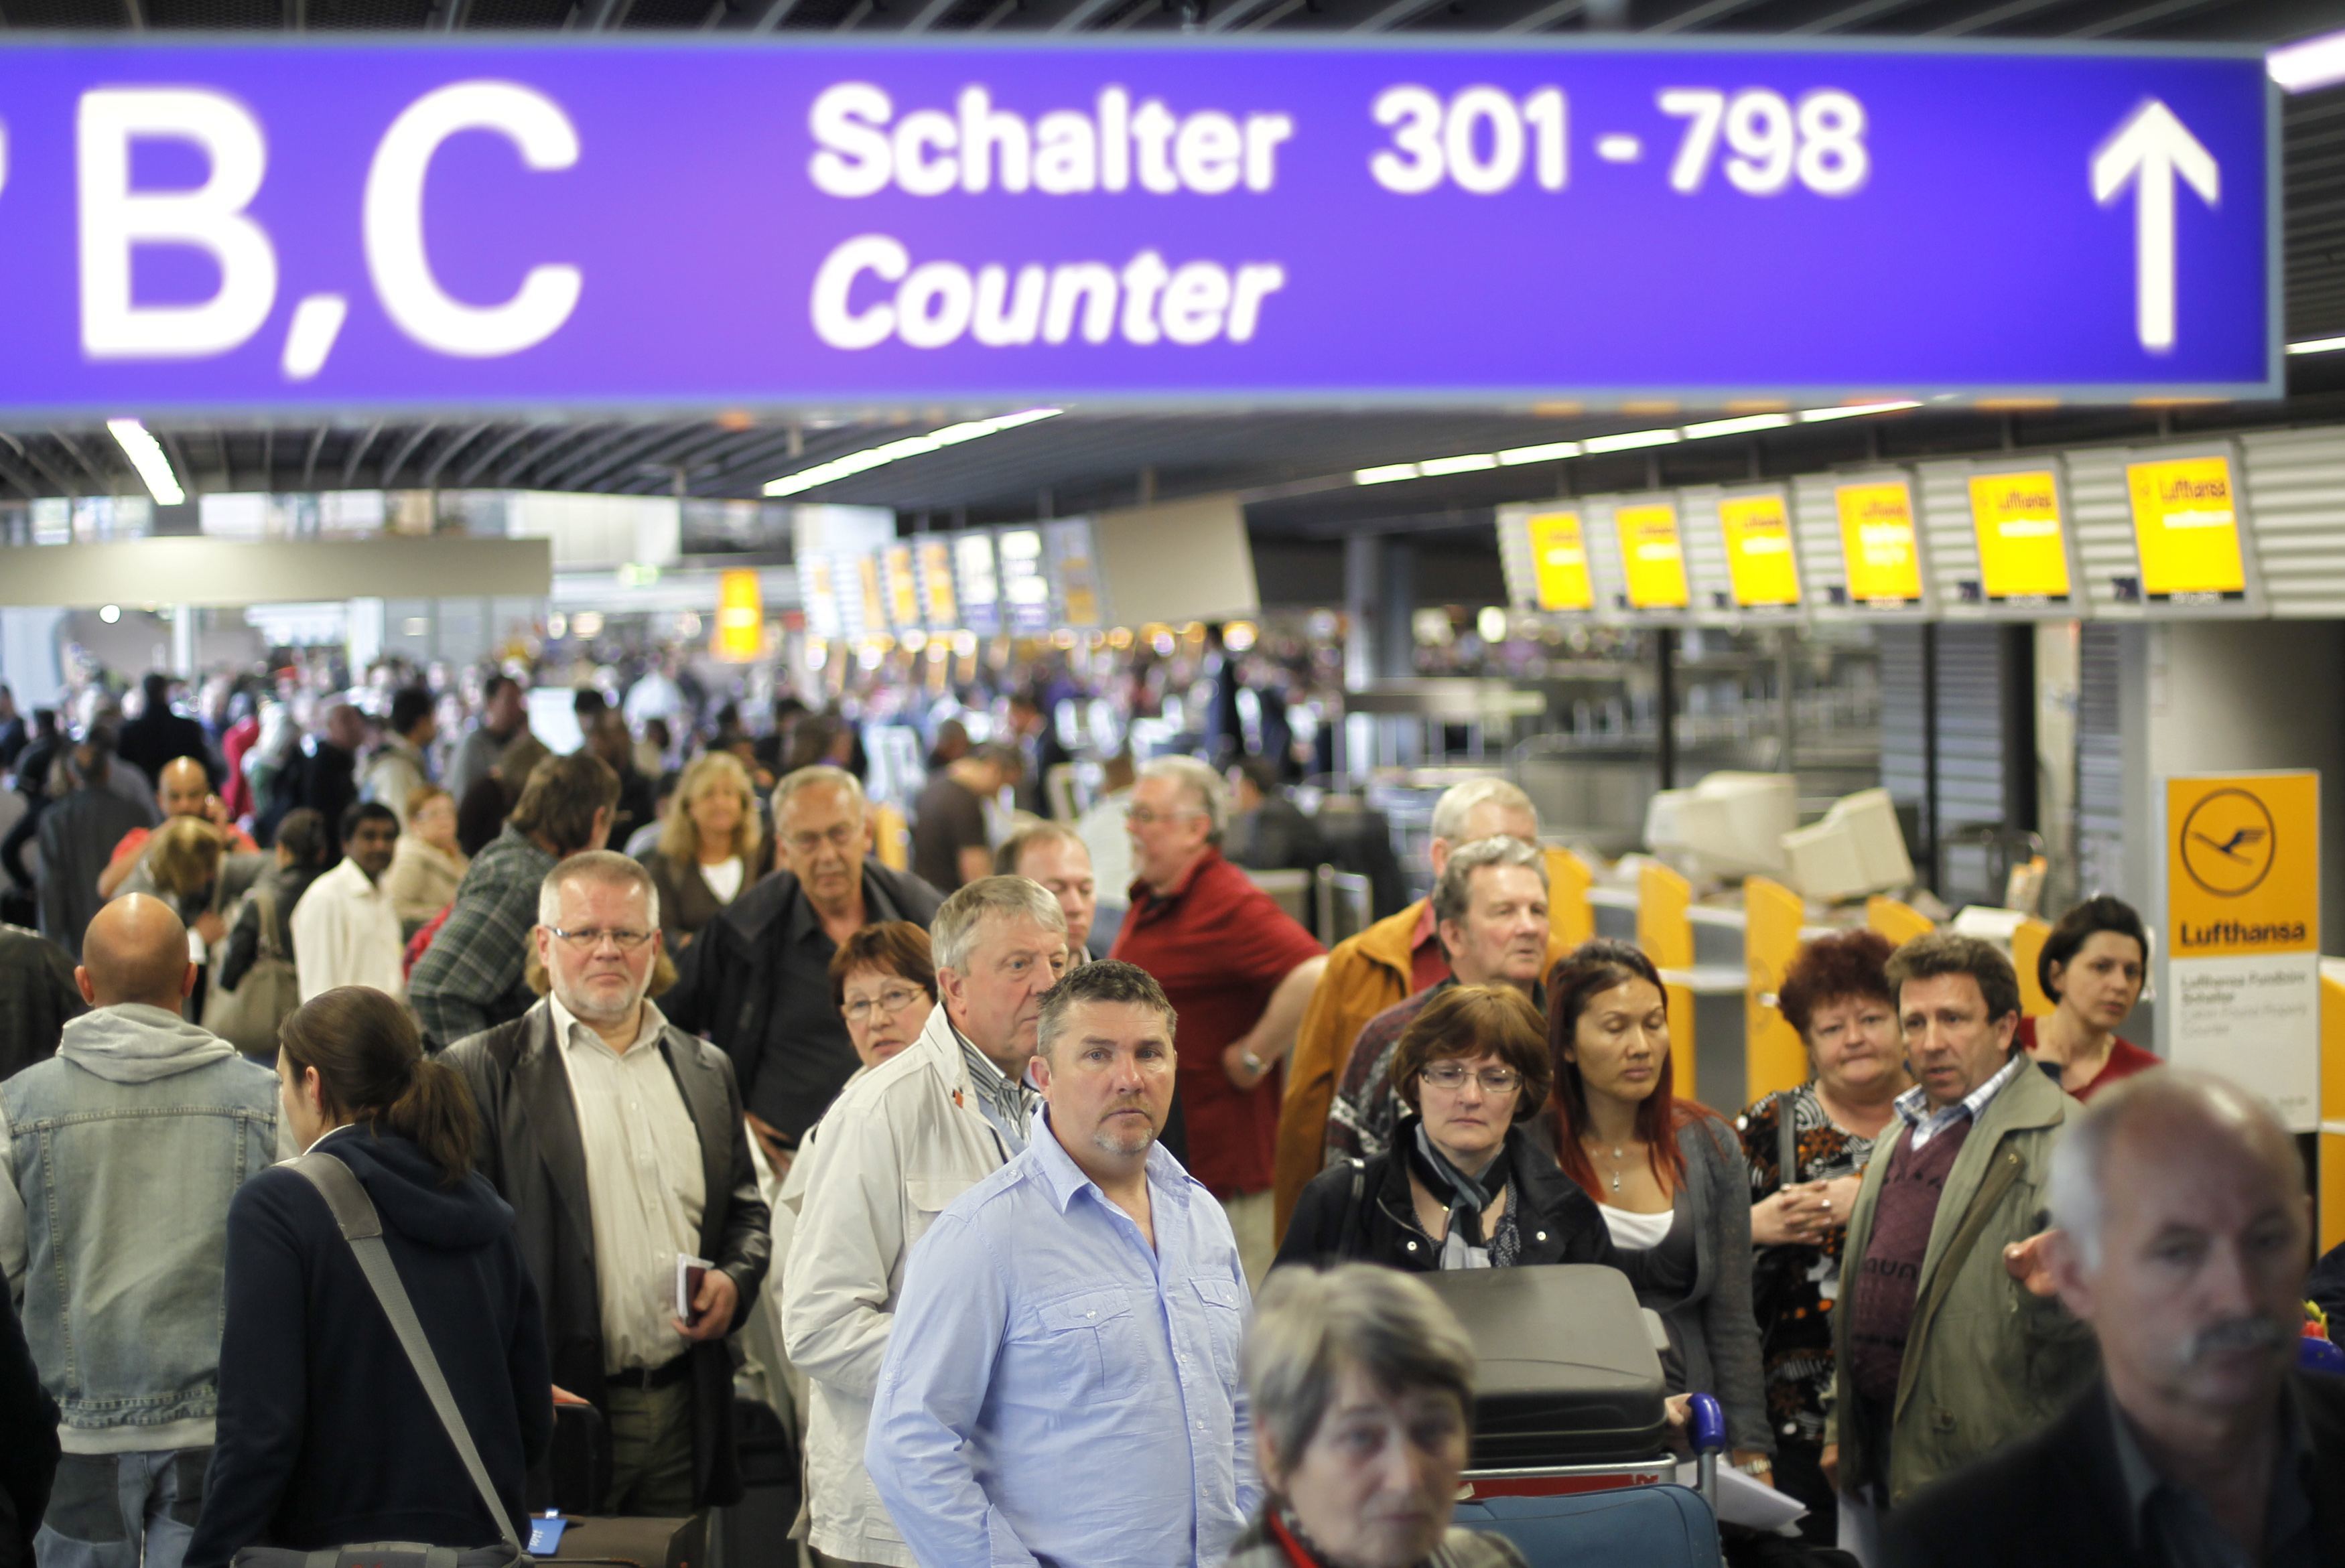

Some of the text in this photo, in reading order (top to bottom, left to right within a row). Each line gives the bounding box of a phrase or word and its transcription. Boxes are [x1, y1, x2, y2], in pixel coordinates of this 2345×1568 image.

[808, 82, 1293, 199] Schalter
[1370, 86, 1568, 194] 301
[1659, 88, 1869, 196] 798
[77, 82, 582, 380] B,C
[809, 234, 1286, 350] Counter
[2180, 918, 2306, 947] Lufthansa
